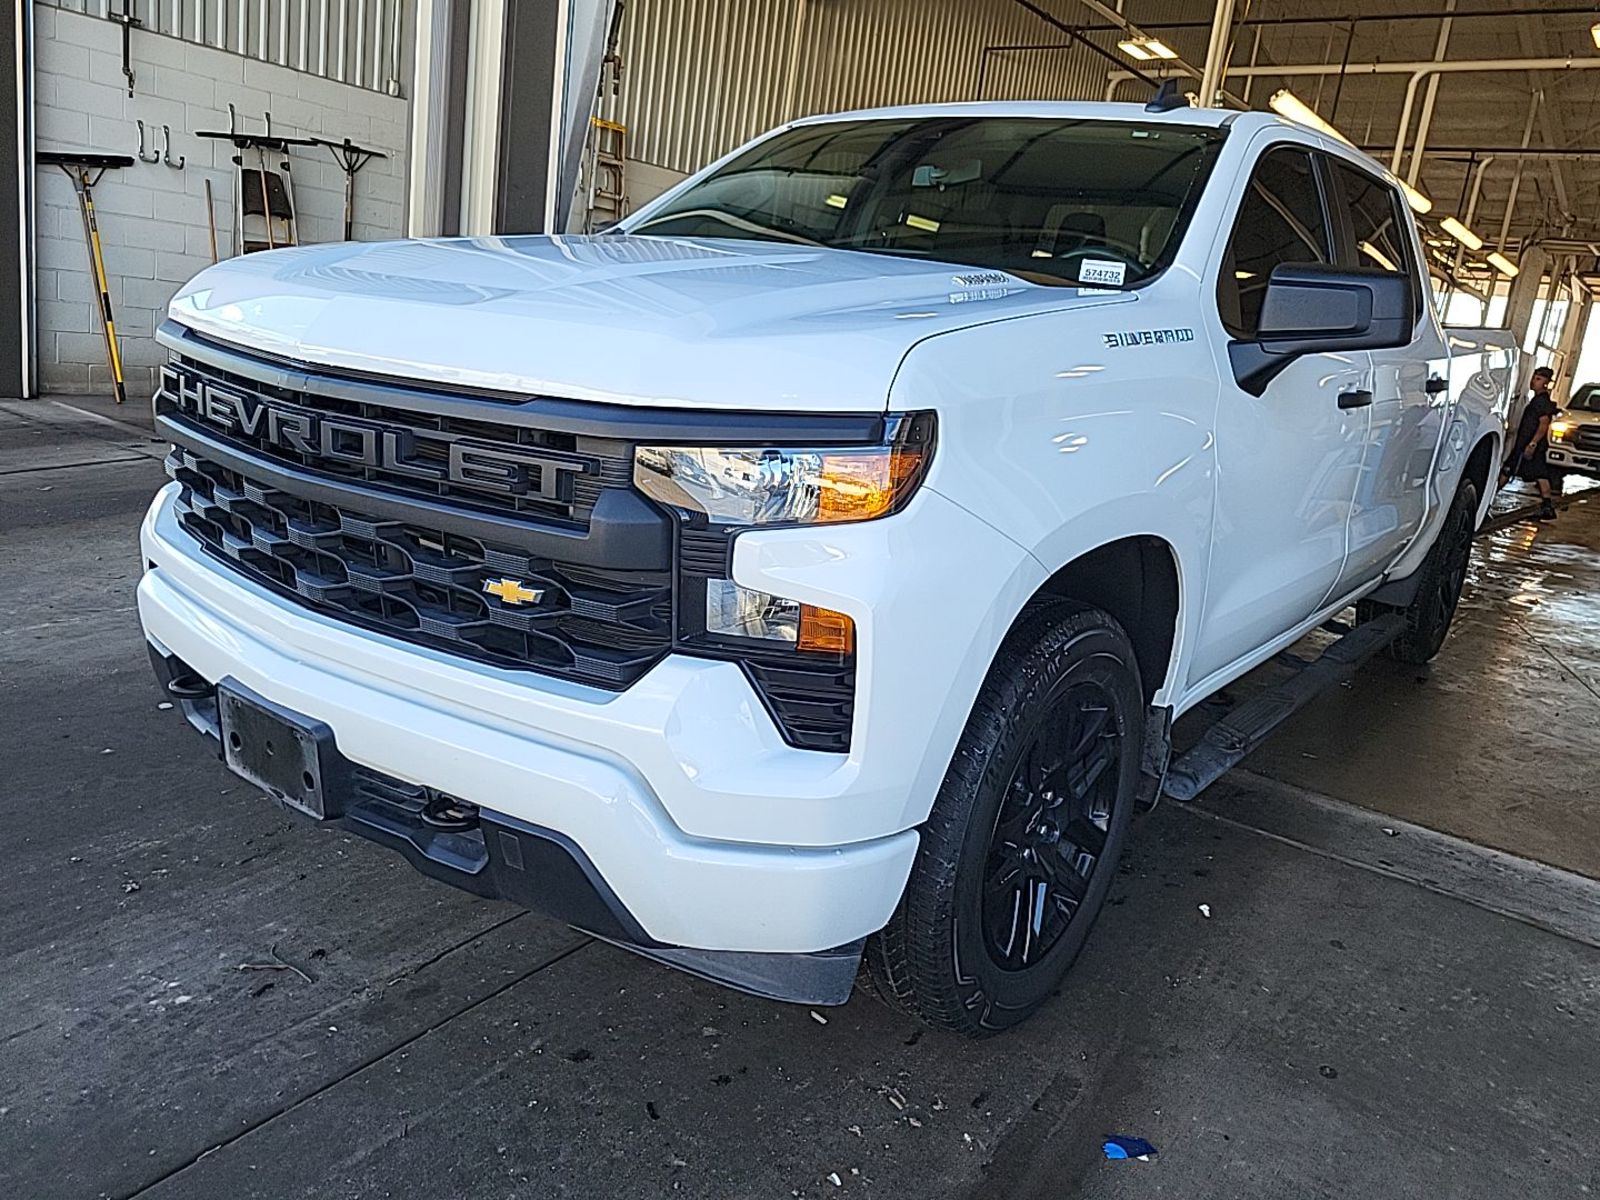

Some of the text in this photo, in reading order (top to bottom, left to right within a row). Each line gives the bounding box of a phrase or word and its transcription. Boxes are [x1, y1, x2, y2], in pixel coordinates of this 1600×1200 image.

[1084, 268, 1121, 280] 574732
[1102, 328, 1194, 348] SILVERADO
[158, 364, 597, 501] CHEVROLET
